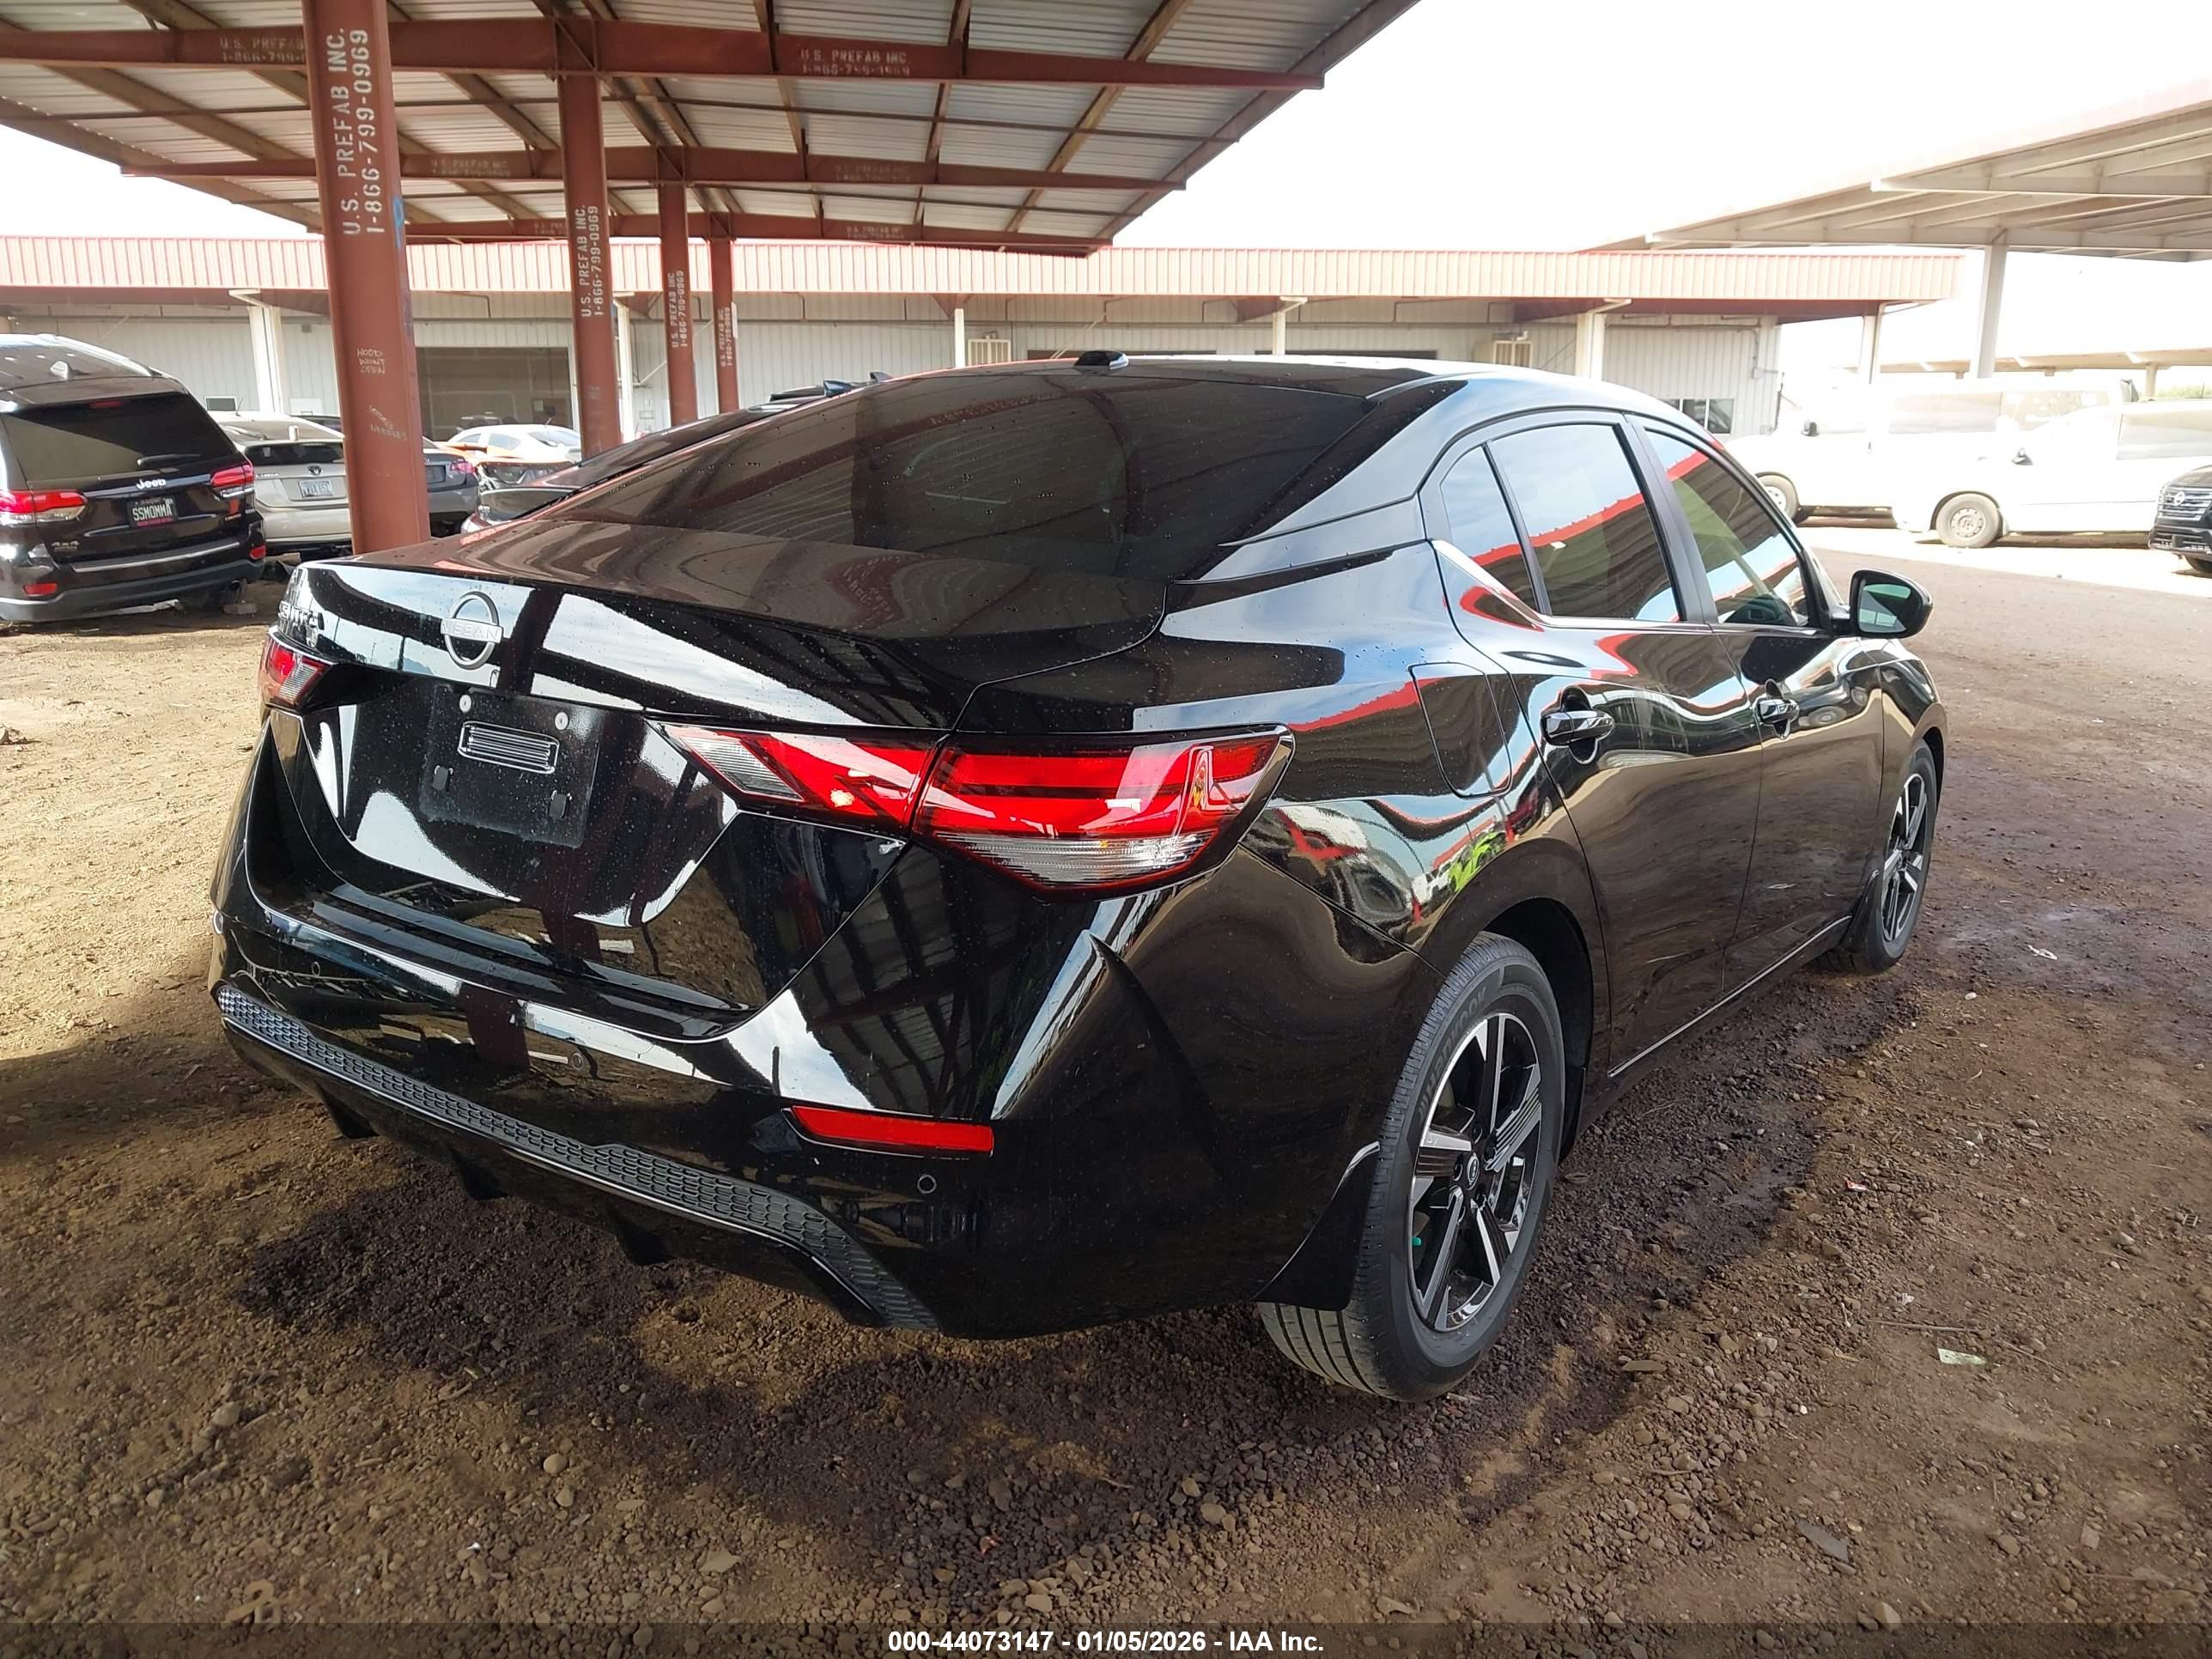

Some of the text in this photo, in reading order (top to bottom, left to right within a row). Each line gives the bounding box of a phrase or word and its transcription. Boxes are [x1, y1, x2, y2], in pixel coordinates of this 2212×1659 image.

[831, 49, 880, 64] PREFAB
[326, 27, 361, 235] U.S. PREFAB INC.
[349, 29, 385, 233] 1-866-799-0969
[576, 236, 591, 286] PREFAB
[587, 205, 605, 316] 1-866-799-0969
[580, 293, 592, 318] U.S.
[357, 349, 383, 357] HOOD
[137, 479, 167, 489] Jeep
[441, 621, 500, 641] NISSAN
